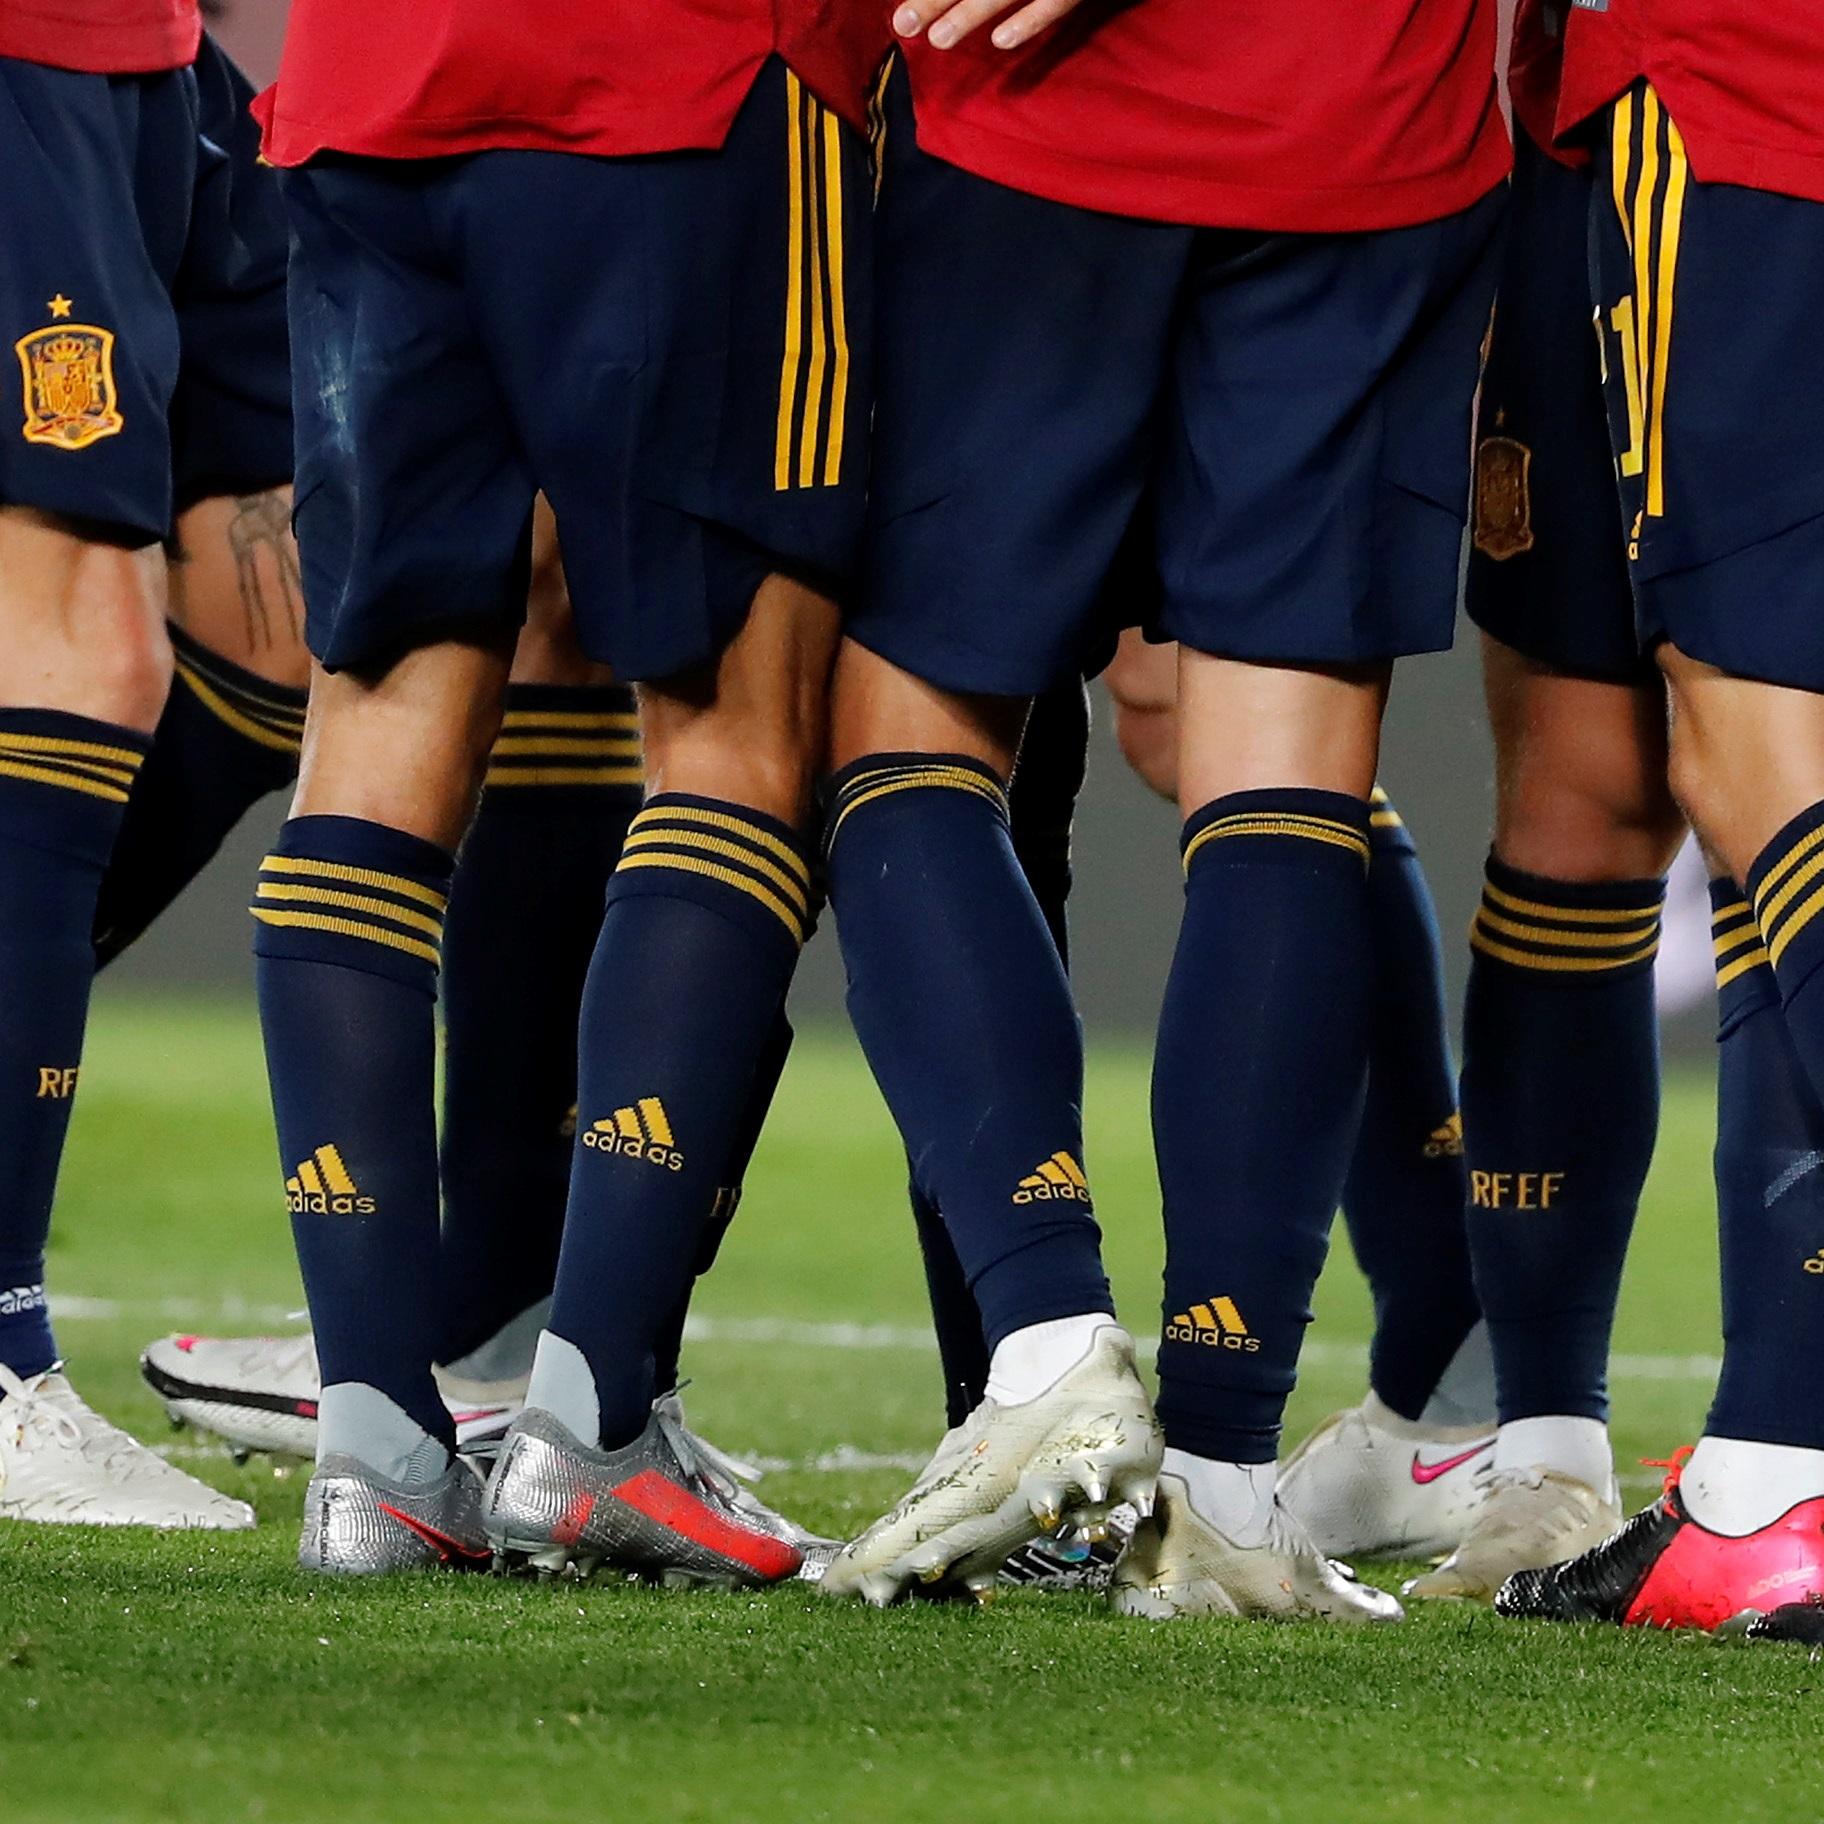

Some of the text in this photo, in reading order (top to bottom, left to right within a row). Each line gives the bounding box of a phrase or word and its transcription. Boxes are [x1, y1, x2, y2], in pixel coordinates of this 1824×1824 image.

[583, 1129, 685, 1171] adidas
[1470, 1169, 1565, 1209] RFEF
[1166, 1322, 1261, 1352] adidas
